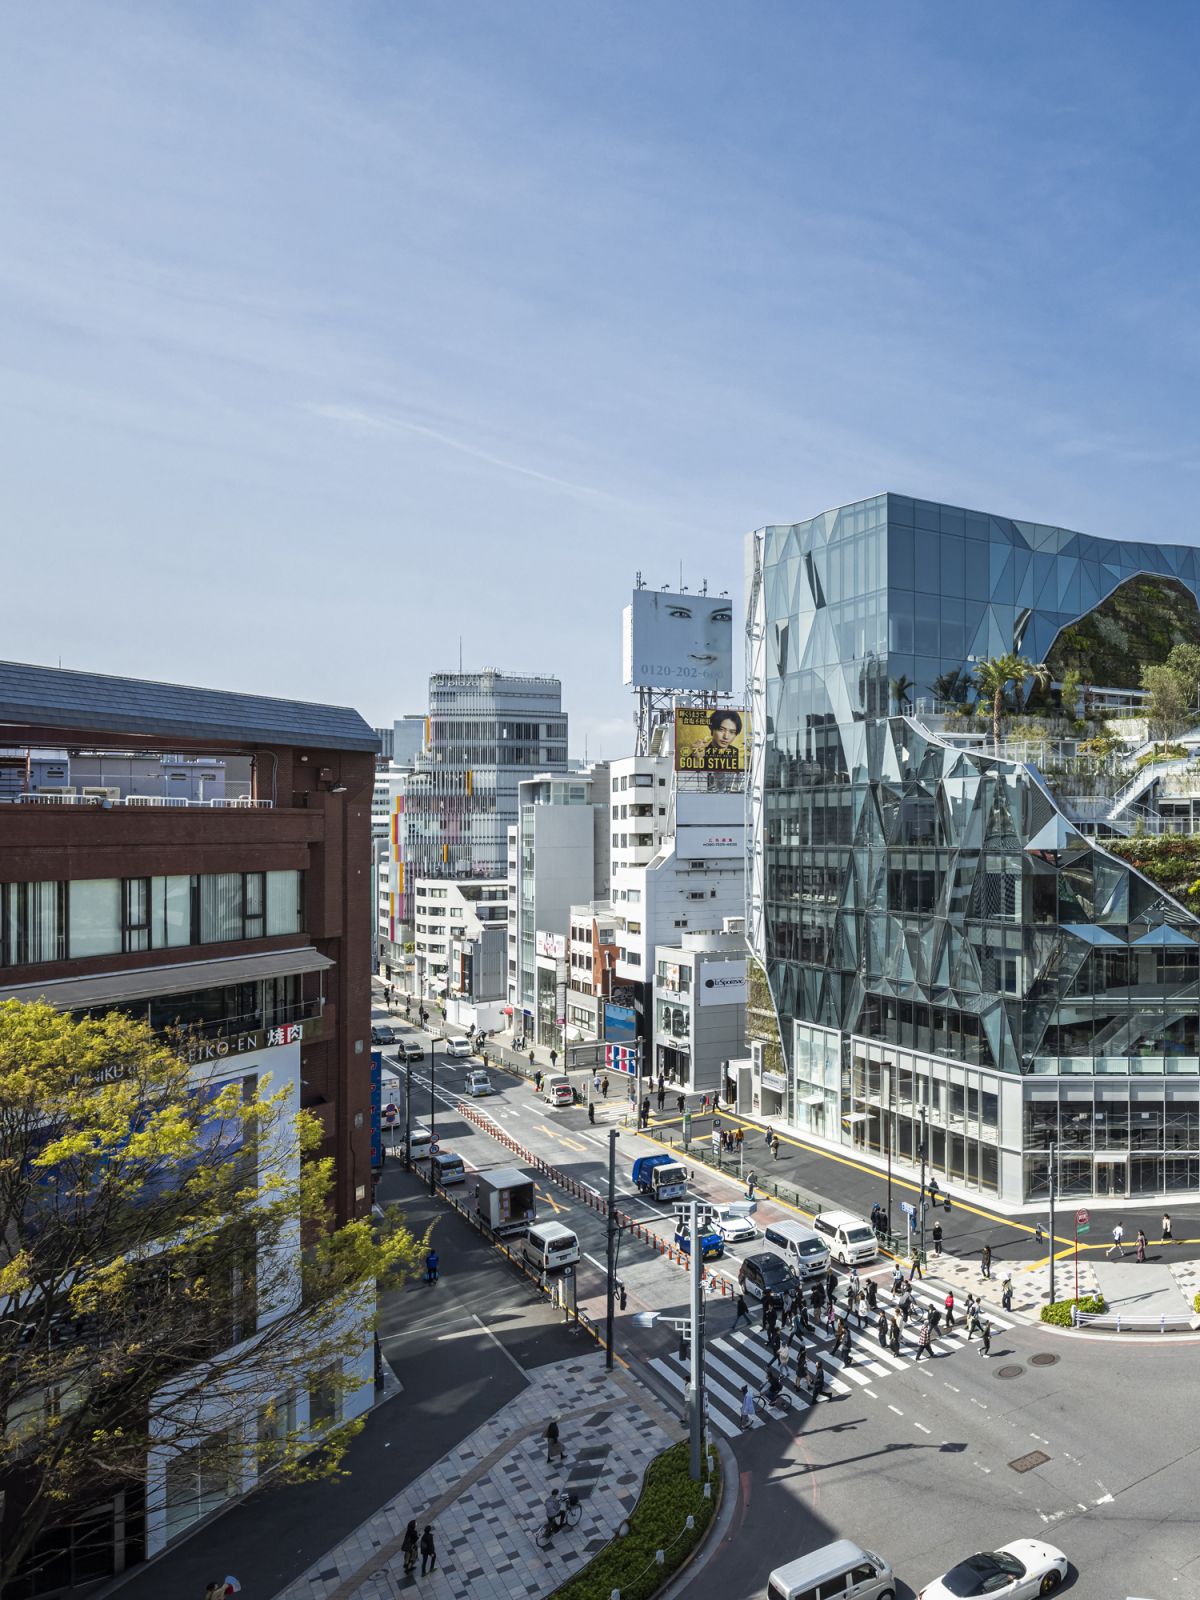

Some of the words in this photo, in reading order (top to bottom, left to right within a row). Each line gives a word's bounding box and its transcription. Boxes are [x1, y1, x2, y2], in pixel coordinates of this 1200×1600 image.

[679, 757, 705, 769] GOLD
[708, 757, 737, 769] STYLE
[267, 1024, 304, 1047] 焼肉
